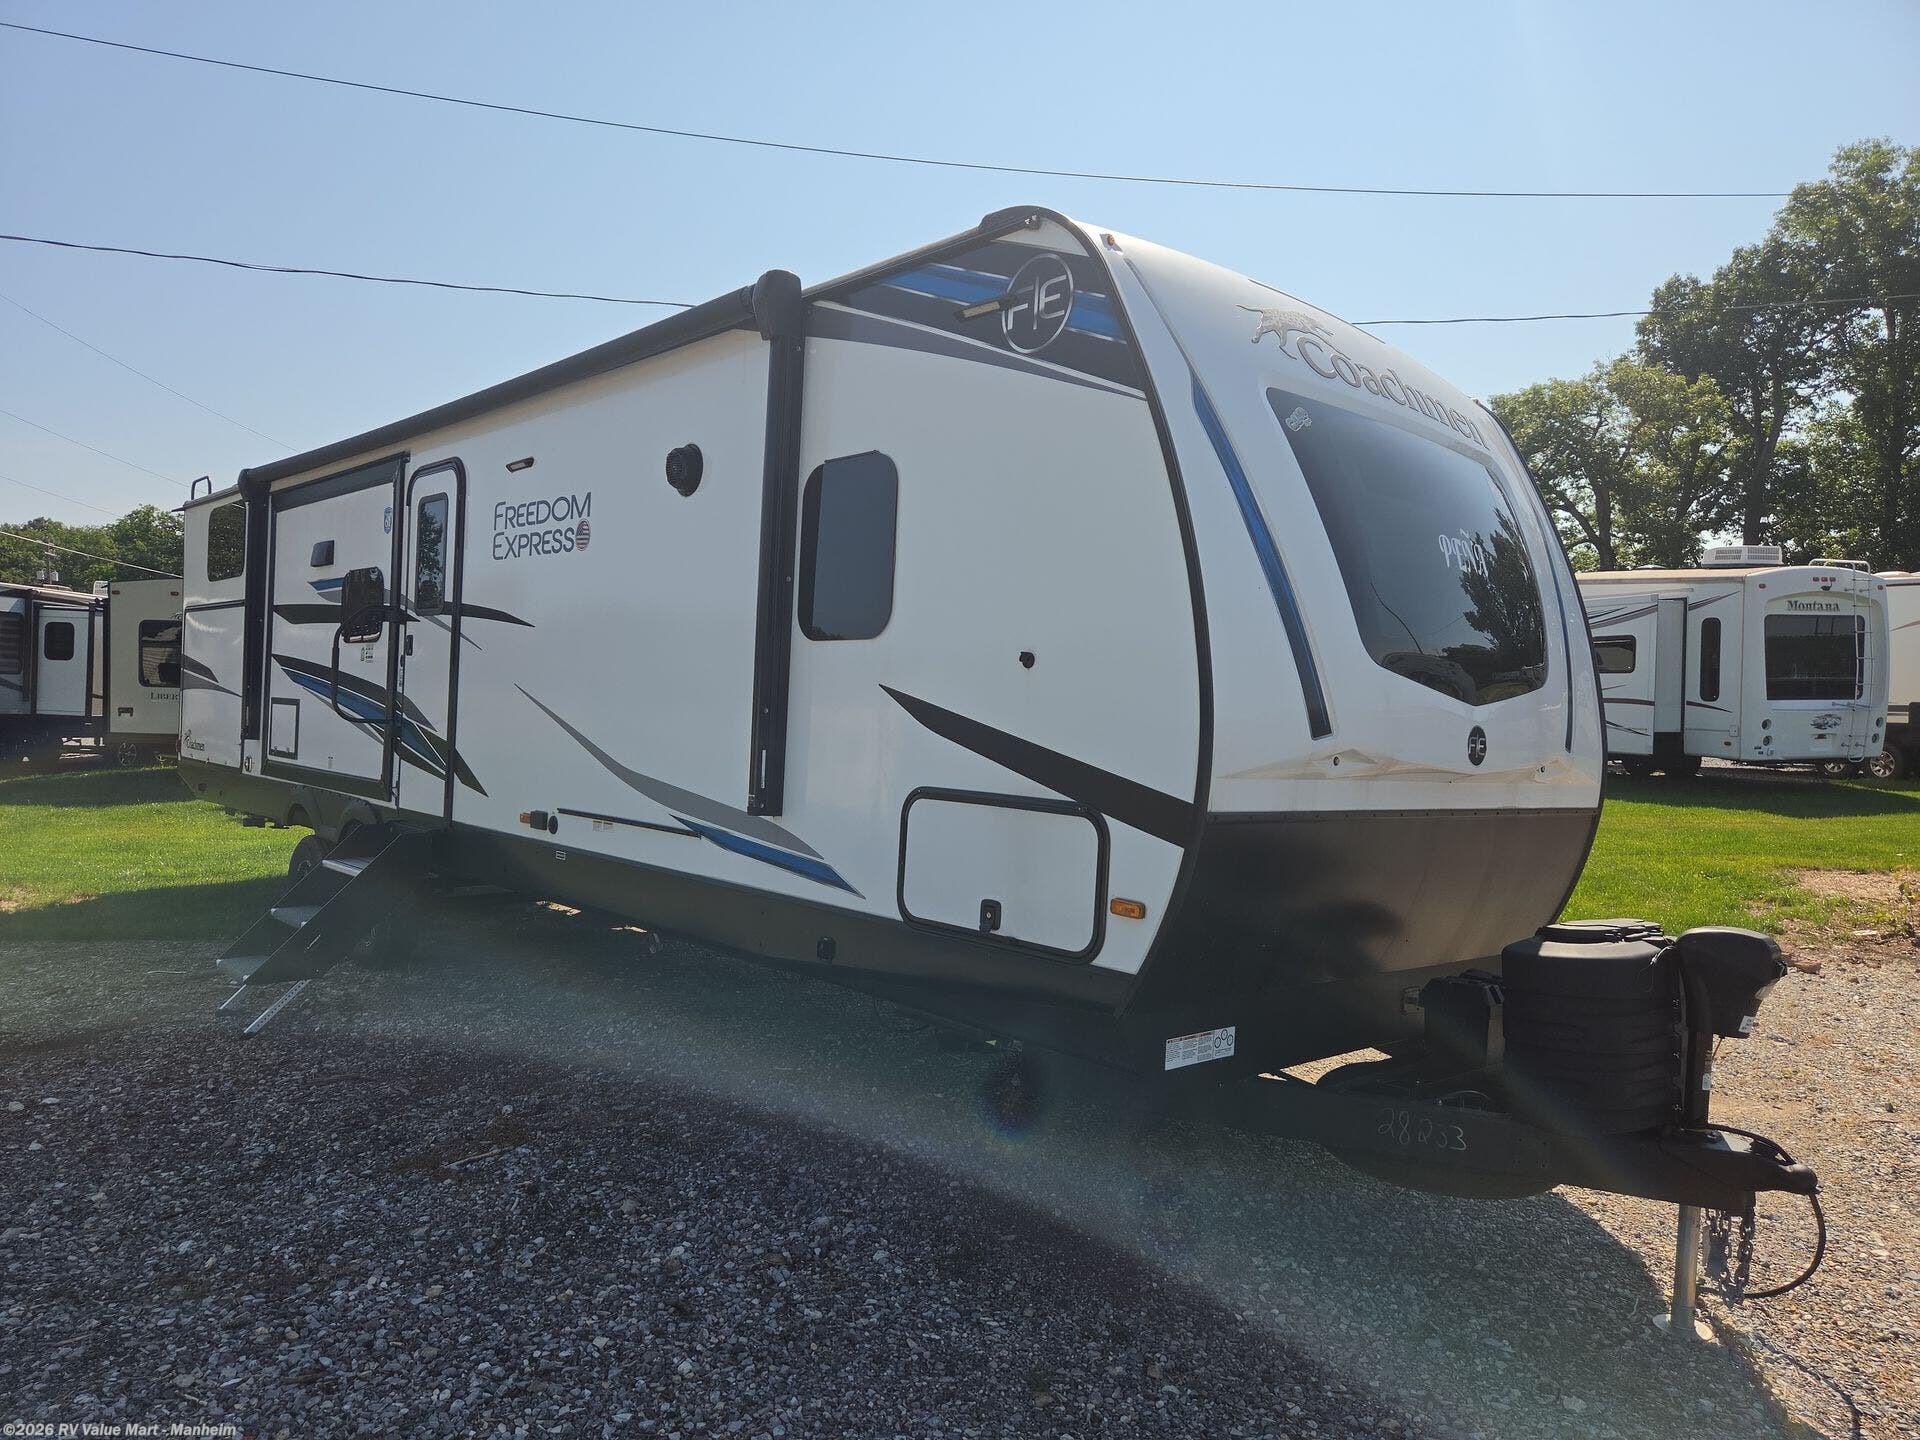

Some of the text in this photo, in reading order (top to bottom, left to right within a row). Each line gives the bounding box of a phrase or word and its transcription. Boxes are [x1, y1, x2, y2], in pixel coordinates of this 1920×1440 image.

[1296, 335, 1491, 451] Coachmen
[493, 491, 592, 531] FREEDOM
[492, 526, 575, 561] EXPRESS
[1786, 599, 1841, 613] Montana
